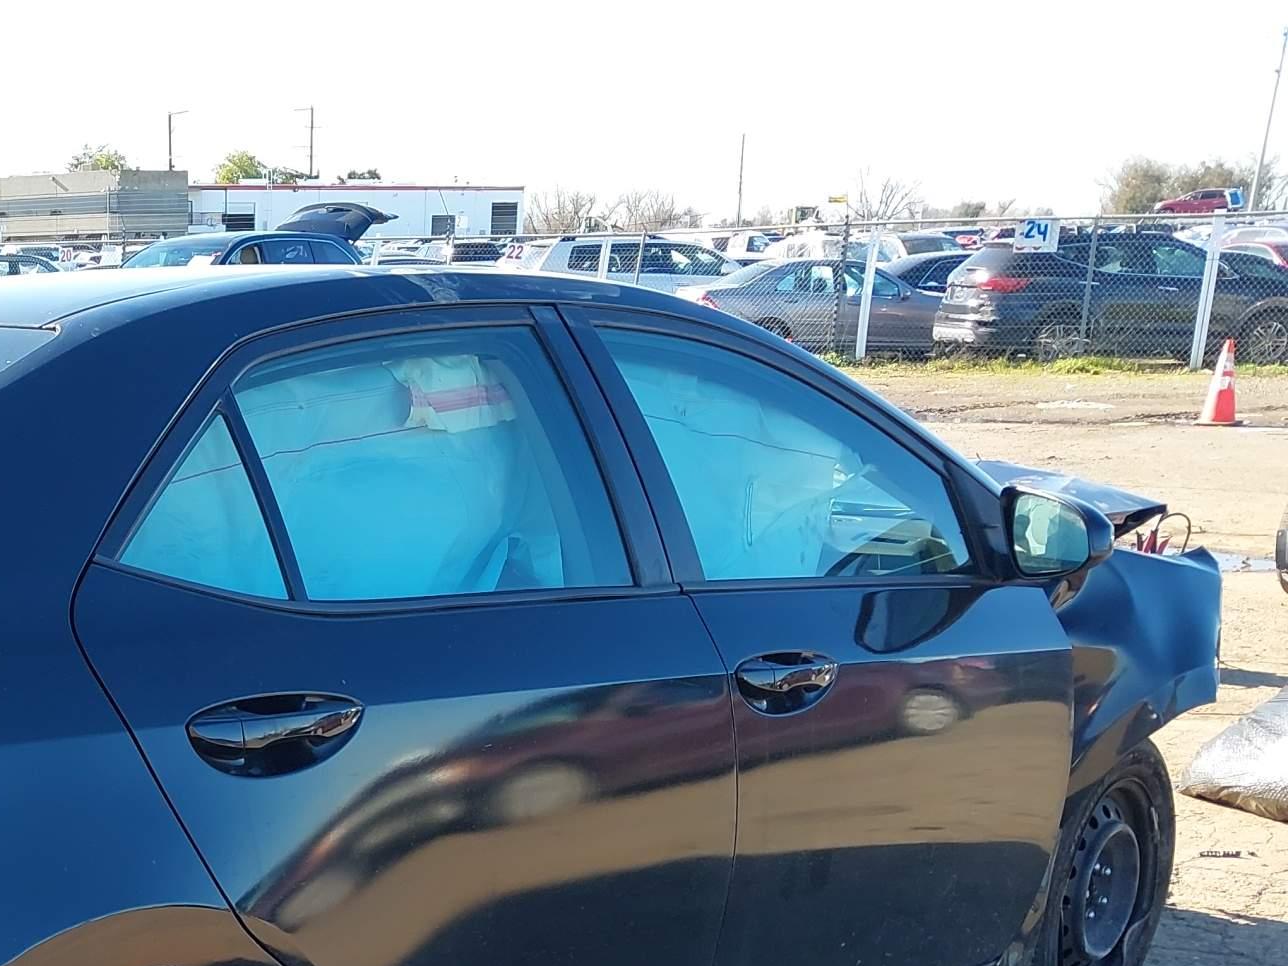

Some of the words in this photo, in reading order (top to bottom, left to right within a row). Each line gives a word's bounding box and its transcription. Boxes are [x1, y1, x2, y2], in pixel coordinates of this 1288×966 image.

[1024, 221, 1048, 241] 24
[61, 249, 72, 262] 20
[507, 245, 523, 259] 22
